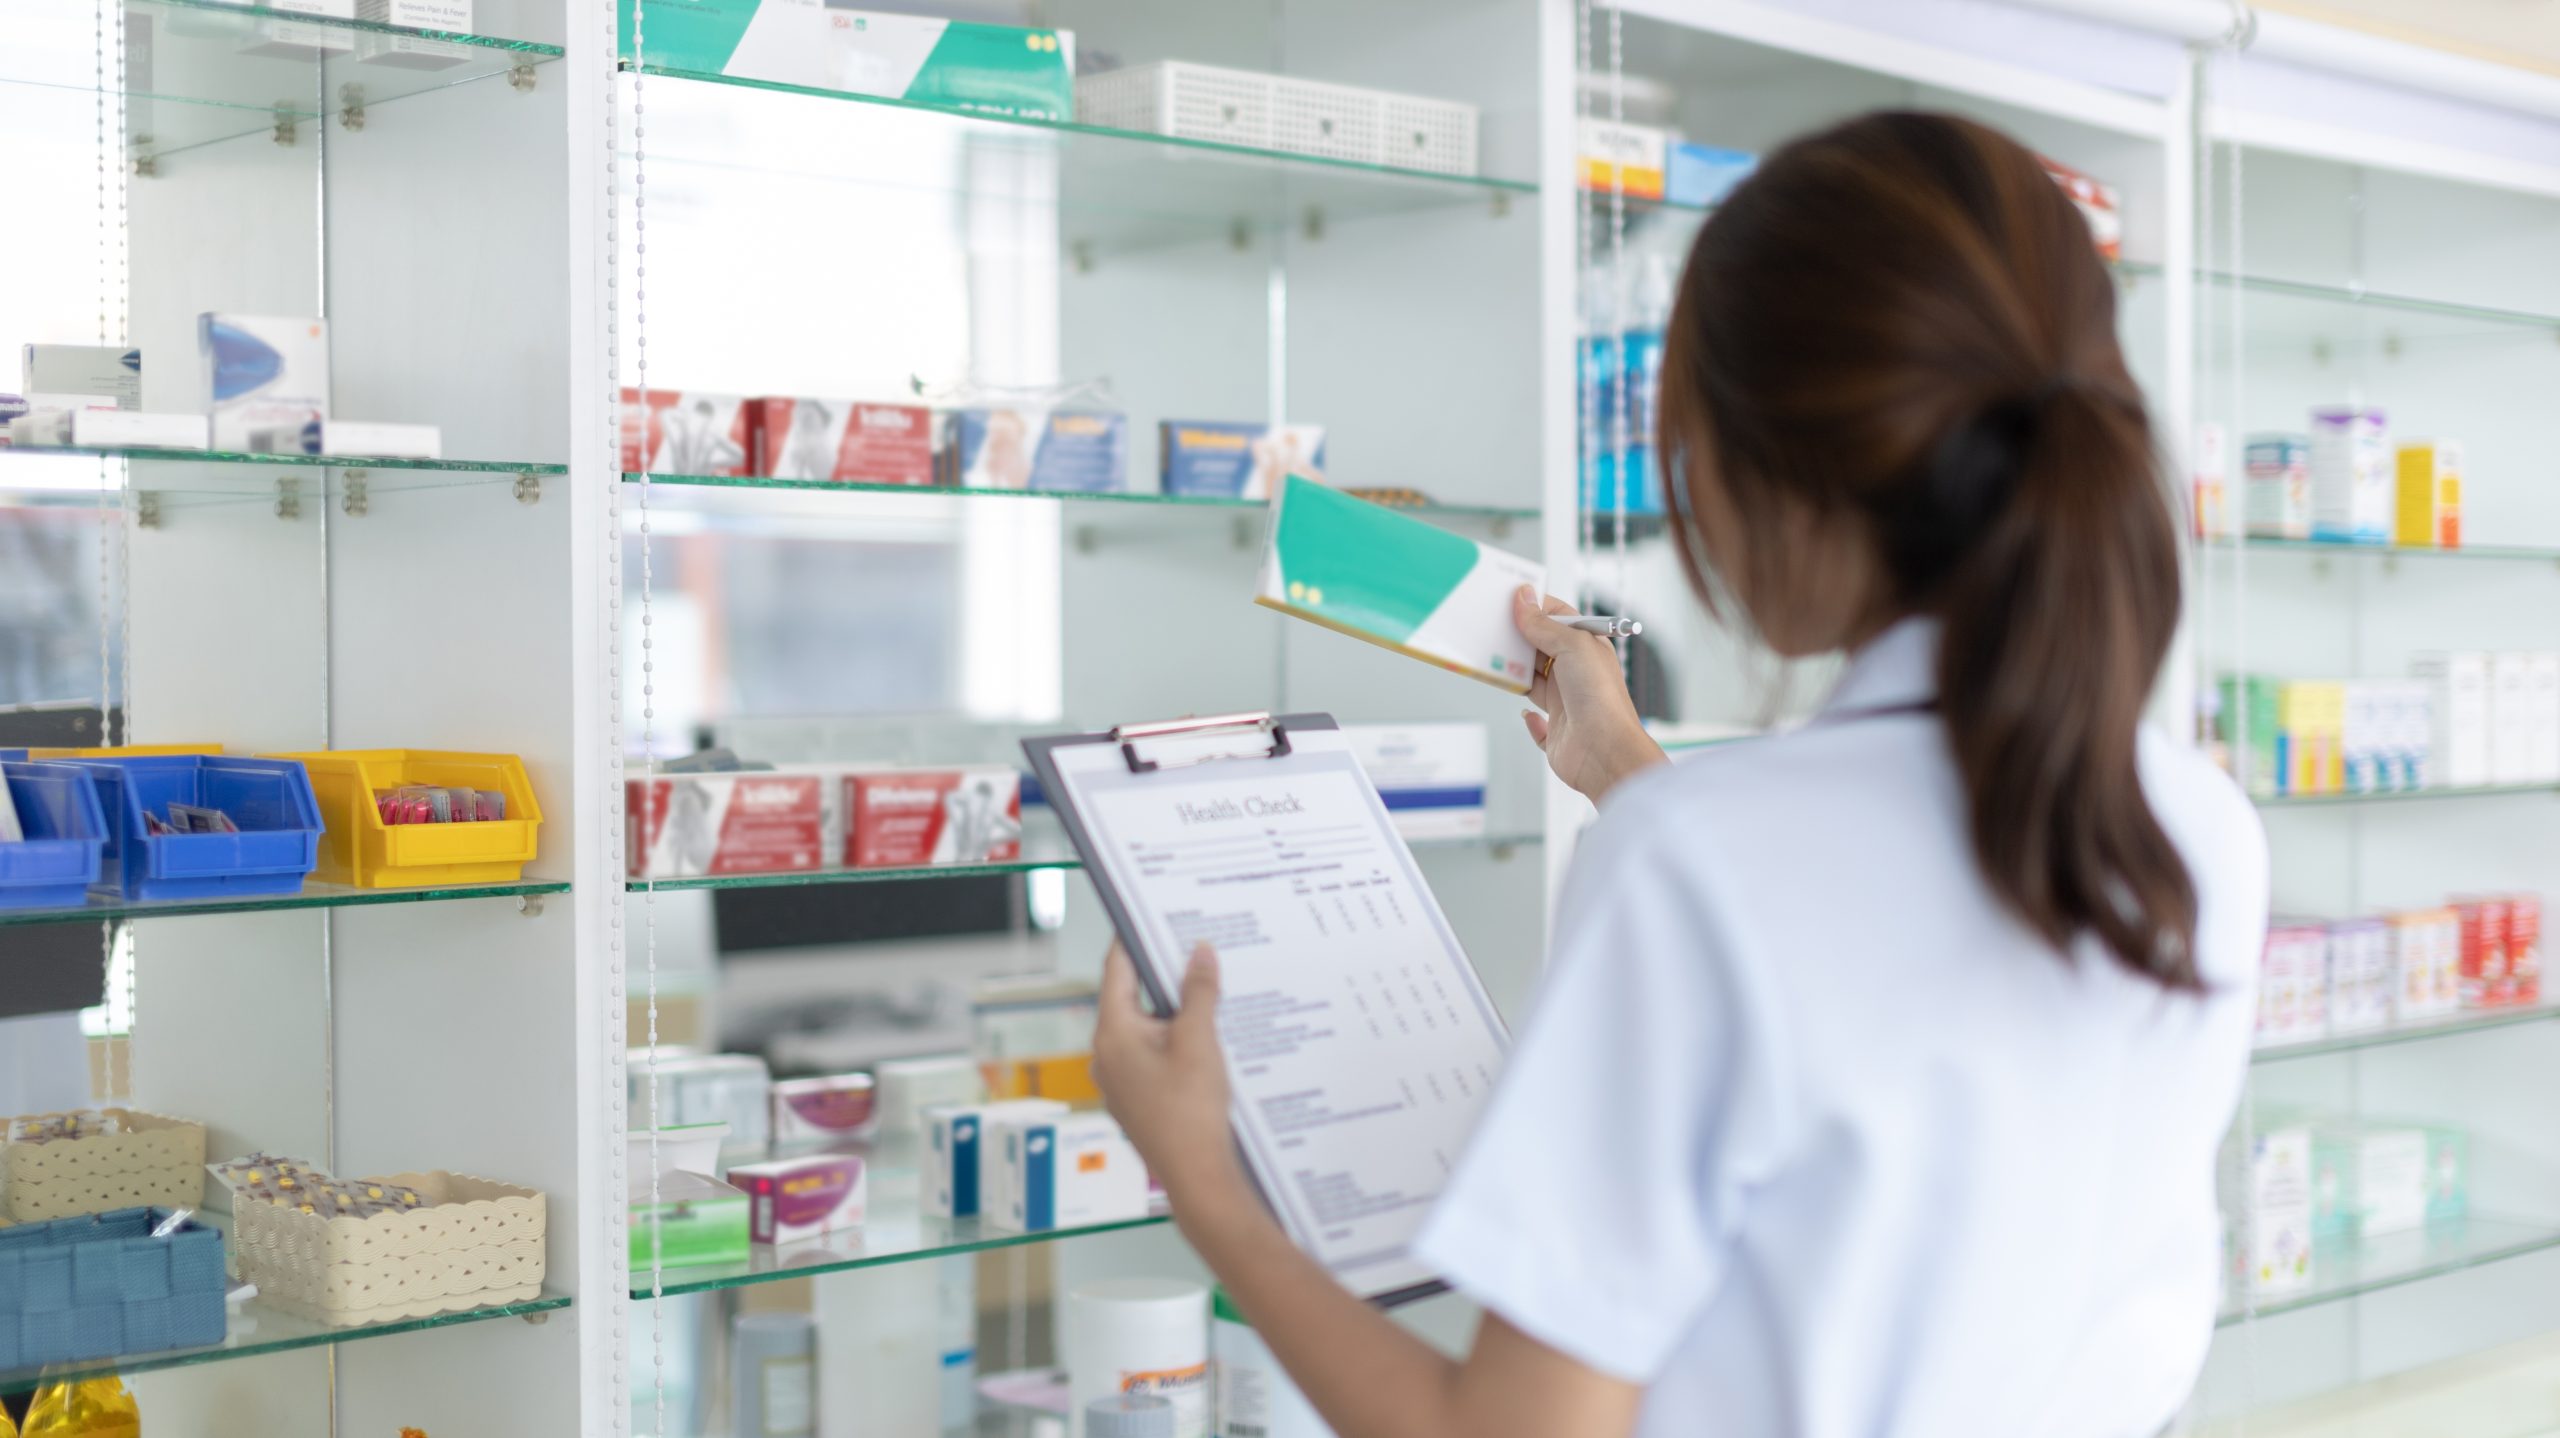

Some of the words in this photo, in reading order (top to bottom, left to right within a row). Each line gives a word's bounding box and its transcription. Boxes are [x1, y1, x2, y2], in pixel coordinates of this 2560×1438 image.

[399, 1, 425, 12] Relieves
[426, 5, 442, 14] Pain
[449, 8, 467, 18] Fever
[1176, 799, 1243, 824] Health
[1244, 792, 1304, 817] Check
